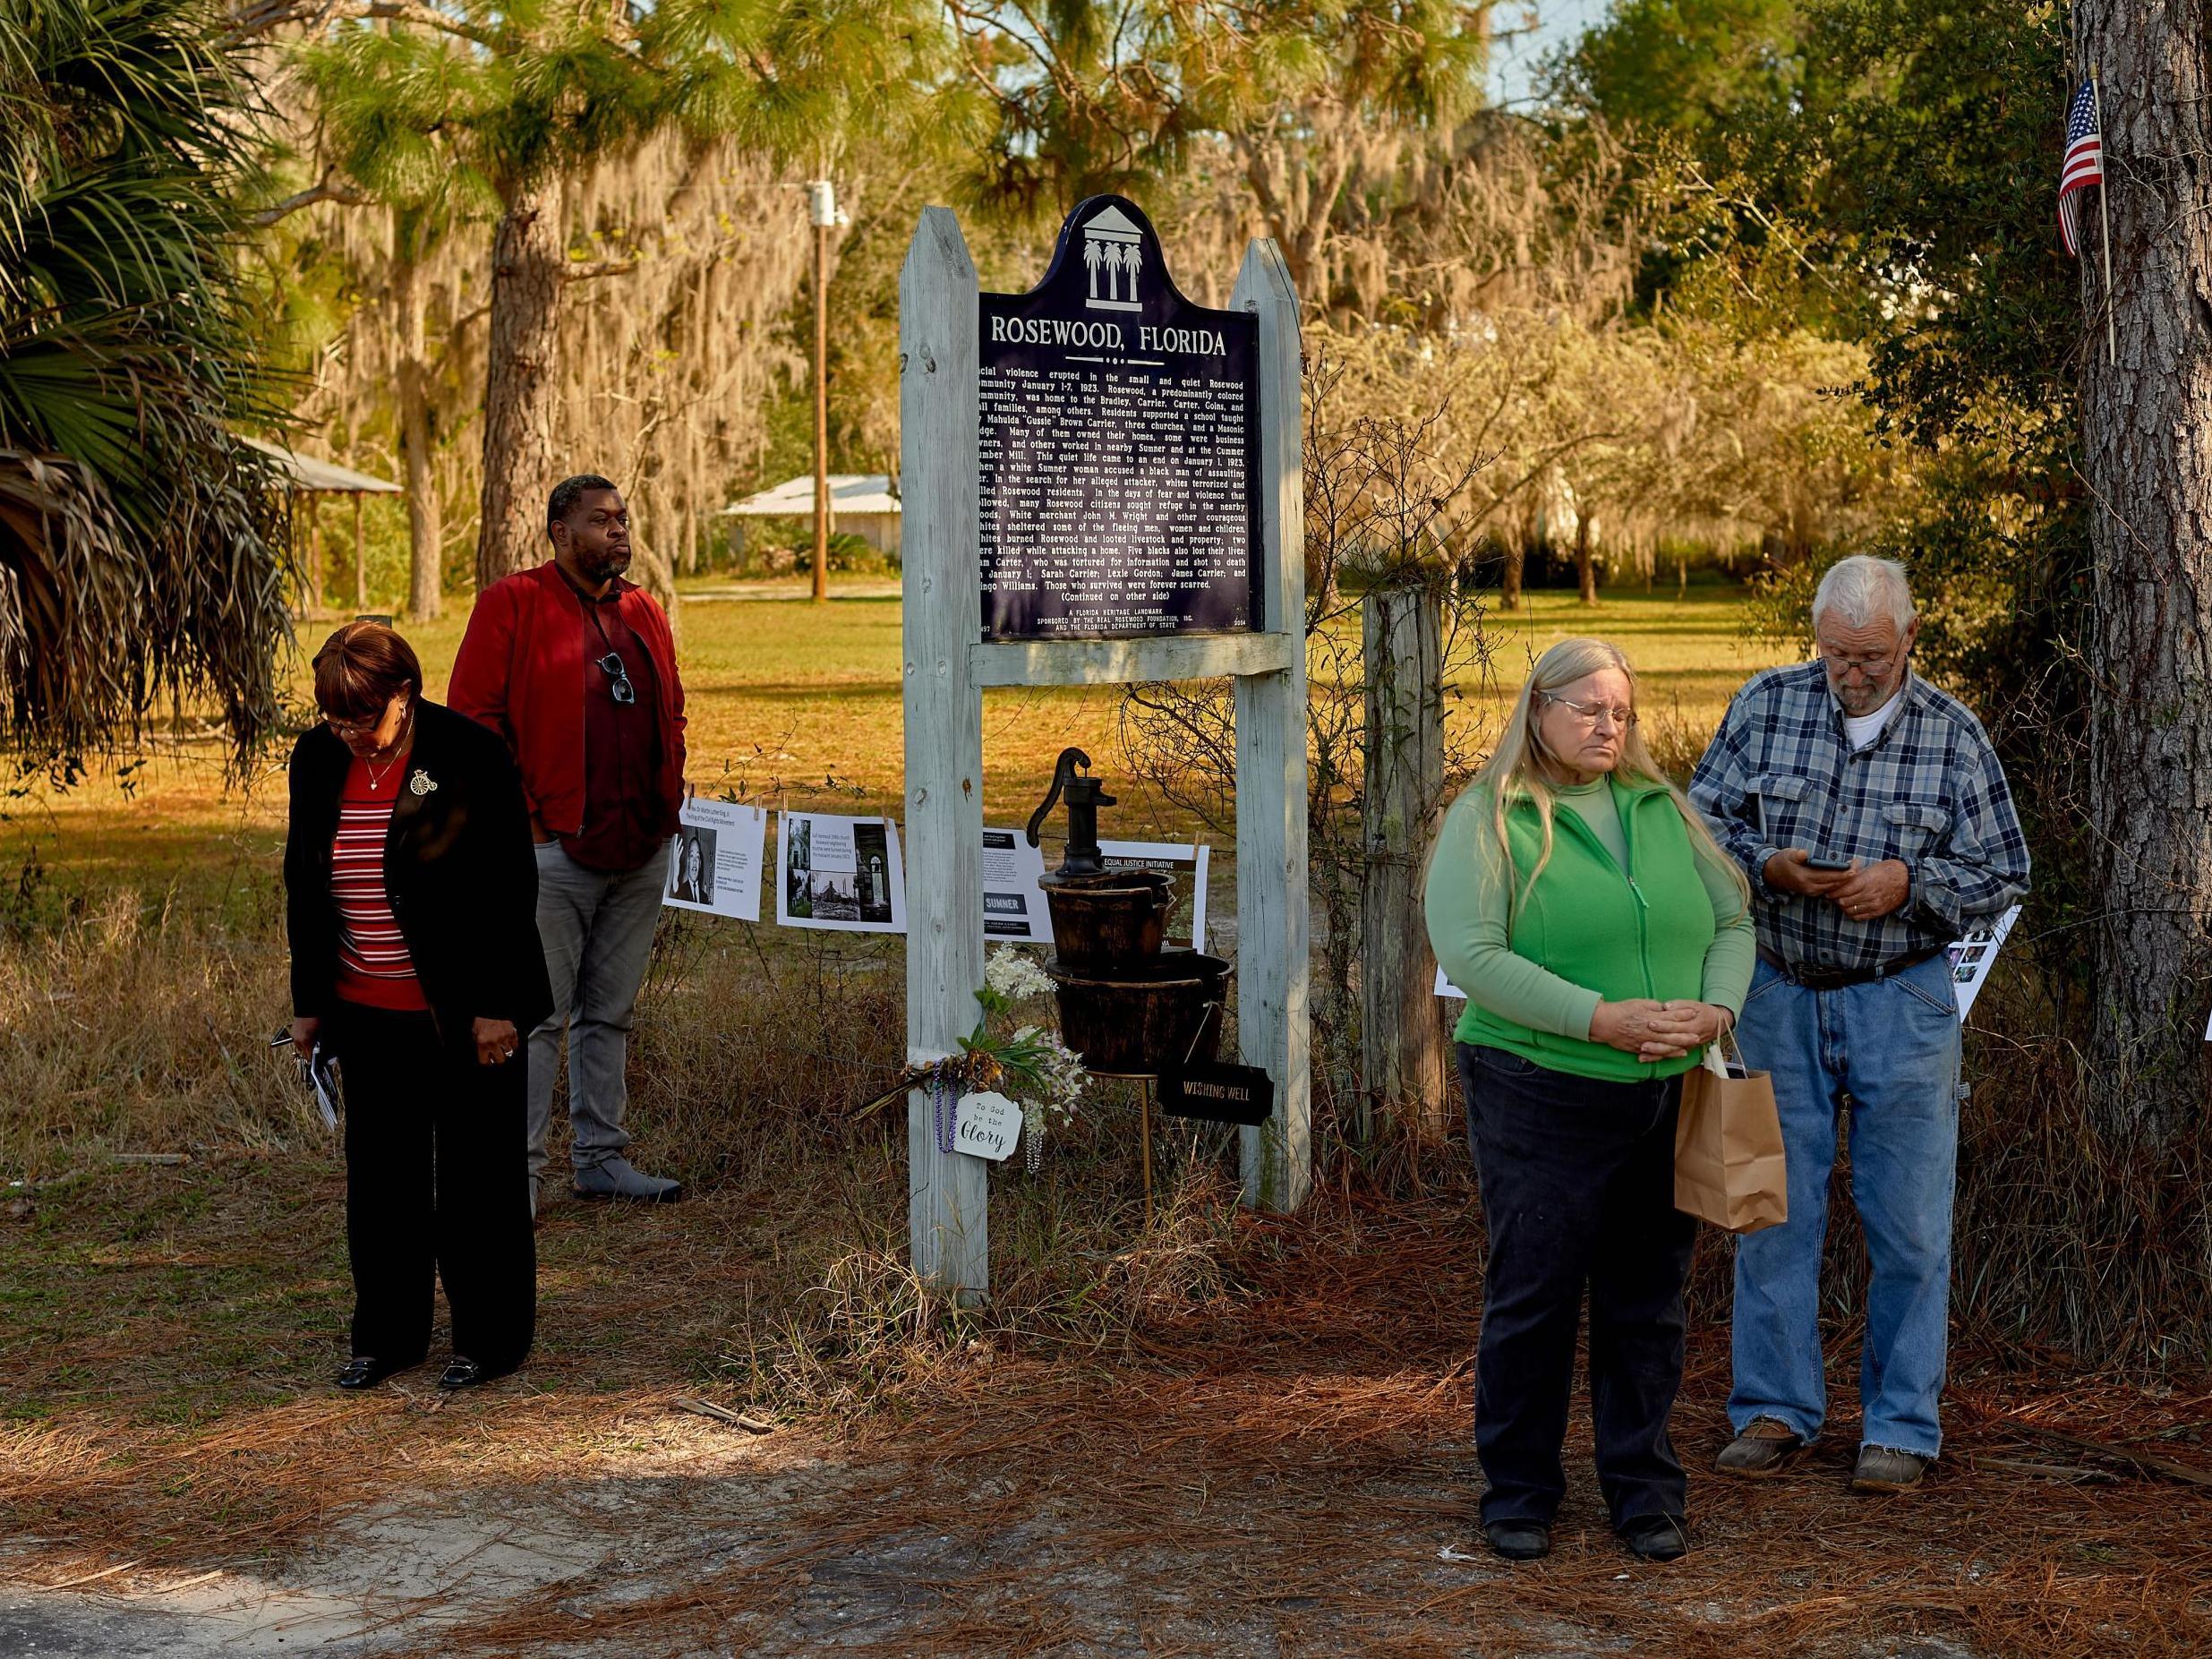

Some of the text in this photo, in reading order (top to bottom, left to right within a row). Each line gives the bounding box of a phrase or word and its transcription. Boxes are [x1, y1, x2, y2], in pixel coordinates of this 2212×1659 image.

[991, 316, 1226, 355] ROSEWOOD, FLORIDA
[1005, 367, 1243, 389] violence erupted small quiet Rosewood
[1021, 379, 1055, 391] January
[1161, 389, 1212, 400] predominantly
[1217, 391, 1243, 400] colored
[1044, 393, 1064, 402] home
[1036, 406, 1061, 416] among
[1101, 406, 1137, 417] Residents
[1142, 410, 1178, 420] supported
[1193, 412, 1216, 421] school
[1221, 414, 1243, 424] taught
[986, 414, 1019, 424] Mahulda
[1060, 416, 1082, 426] Brown
[1124, 419, 1145, 429] three
[1217, 423, 1243, 433] Masonic
[1009, 426, 1029, 438] Many
[1051, 428, 1070, 438] them
[1076, 430, 1100, 439] owned
[1106, 430, 1125, 440] their
[1215, 434, 1244, 444] business
[1029, 440, 1244, 456] others worked nearby Sumner Cummer
[1058, 451, 1078, 463] quiet
[1183, 456, 1213, 466] January
[1010, 462, 1244, 480] white Sumner woman accused black assaulting
[1025, 475, 1052, 483] search
[1090, 475, 1118, 488] alleged
[1165, 478, 1187, 487] whites
[1191, 479, 1228, 488] terrorized
[1002, 485, 1040, 496] Rosewood
[1195, 490, 1225, 500] violence
[1019, 498, 1245, 512] many Rosewood citizens sought refuge nearby
[1009, 509, 1245, 524] White merchant John Wright other courageous
[1007, 521, 1045, 531] sheltered
[1053, 523, 1072, 531] some
[1112, 522, 1138, 534] fleeing
[1168, 525, 1192, 533] women
[1006, 534, 1034, 543] burned
[1040, 534, 1078, 543] Rosewood
[1102, 534, 1126, 543] looted
[1131, 534, 1166, 543] livestock
[996, 544, 1021, 555] killed
[1026, 545, 1046, 555] while
[1051, 545, 1087, 557] attacking
[1147, 545, 1170, 554] blacks
[1072, 557, 1105, 567] tortured
[1126, 557, 1169, 566] information
[1226, 557, 1245, 566] death
[988, 569, 1021, 579] January
[1040, 569, 1063, 578] Sarah
[1107, 569, 1128, 577] Lexie
[1171, 569, 1193, 577] James
[1045, 580, 1067, 590] Those
[1089, 580, 1123, 589] survived
[1127, 581, 1145, 589] were
[1149, 579, 1177, 589] forever
[1061, 591, 1146, 602] (Continued other
[1104, 858, 1174, 869] EQUAL JUSTICE INITIATIVE
[986, 897, 1019, 910] SUMNER
[1183, 1081, 1251, 1101] WISHING WELL
[976, 1102, 1004, 1116] To God
[973, 1113, 1003, 1127] be the
[961, 1119, 1007, 1153] Glory
